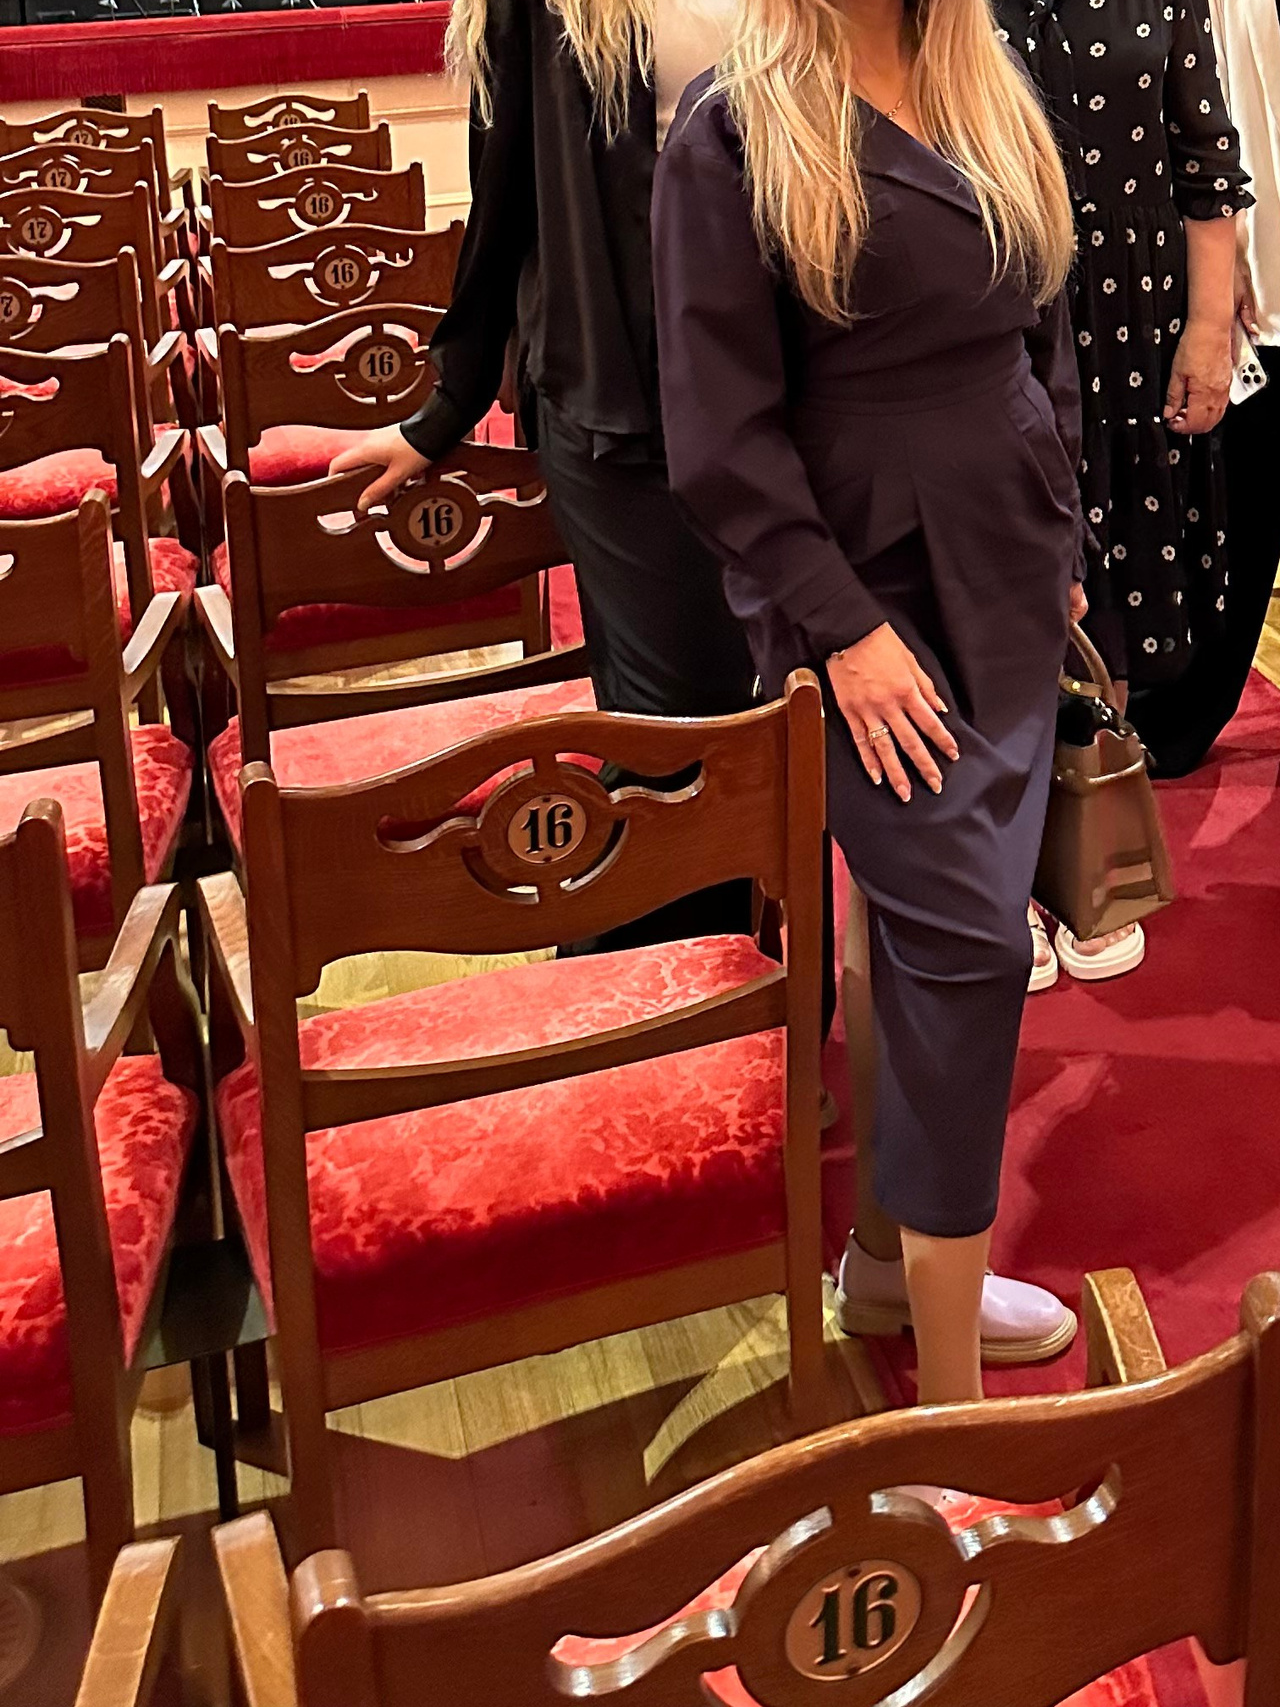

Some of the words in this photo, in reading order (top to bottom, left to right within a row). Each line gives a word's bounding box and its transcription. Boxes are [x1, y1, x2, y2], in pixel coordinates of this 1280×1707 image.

[292, 151, 309, 167] 16
[50, 171, 67, 186] 17
[309, 196, 329, 214] 16
[28, 221, 47, 240] 17
[331, 263, 354, 284] 16
[366, 351, 394, 377] 16
[418, 504, 454, 540] 16
[520, 802, 574, 854] 16
[809, 1571, 899, 1666] 16
